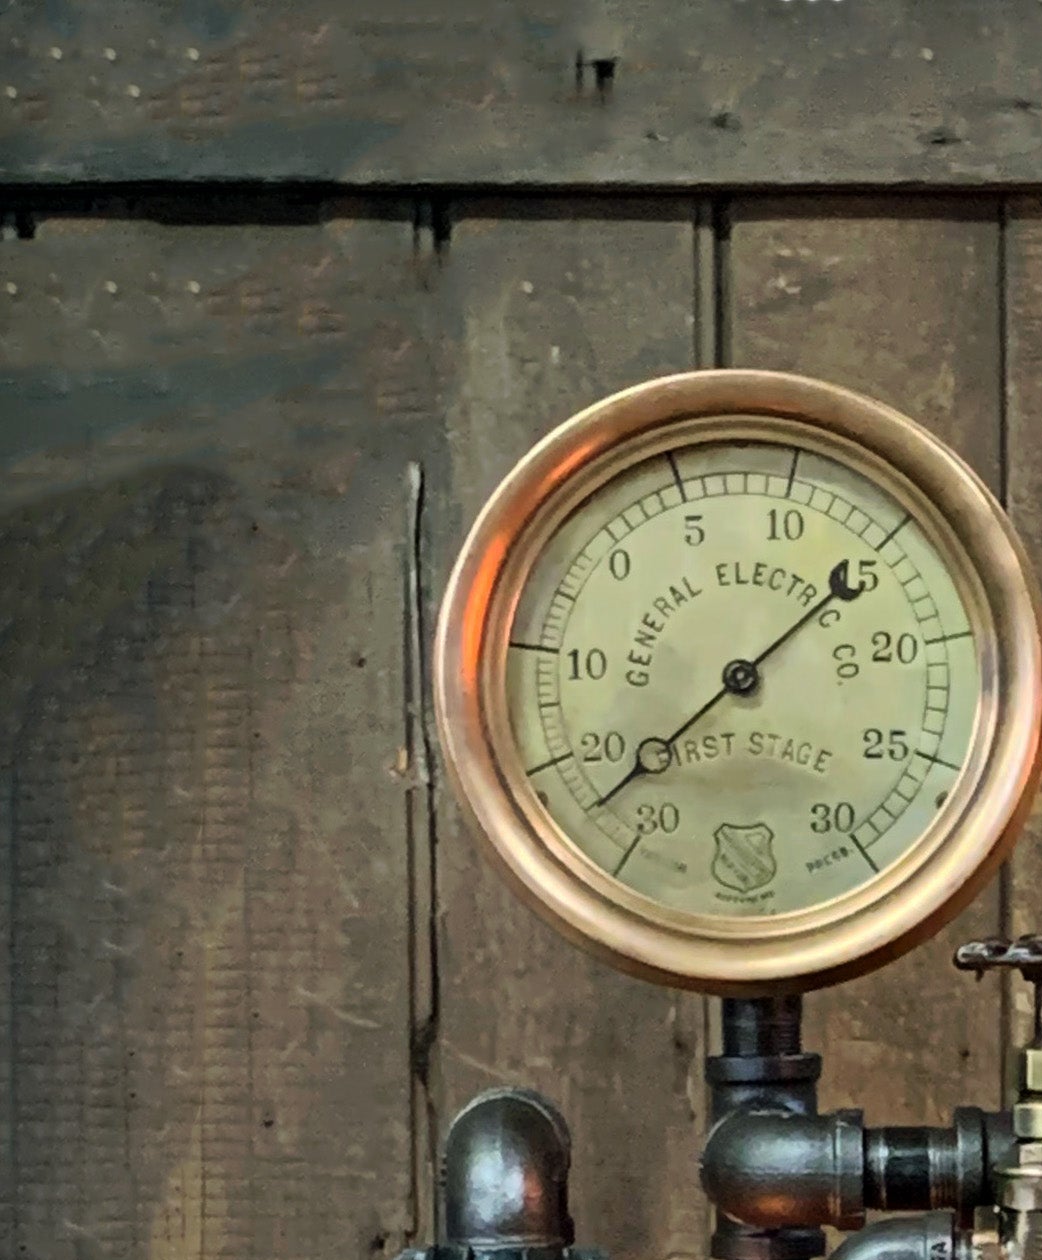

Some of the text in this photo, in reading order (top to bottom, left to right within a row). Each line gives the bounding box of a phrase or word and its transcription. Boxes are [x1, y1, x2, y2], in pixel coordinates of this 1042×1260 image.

[684, 515, 705, 546] 5
[766, 509, 804, 541] 10
[609, 549, 630, 581] 0
[625, 561, 860, 687] GENERAL ELECTRC CO.
[567, 648, 607, 680] 10
[871, 632, 918, 664] 20
[581, 732, 626, 762] 20
[749, 731, 833, 773] STAGE
[862, 728, 909, 761] 25
[636, 803, 680, 834] 30
[810, 802, 855, 833] 30
